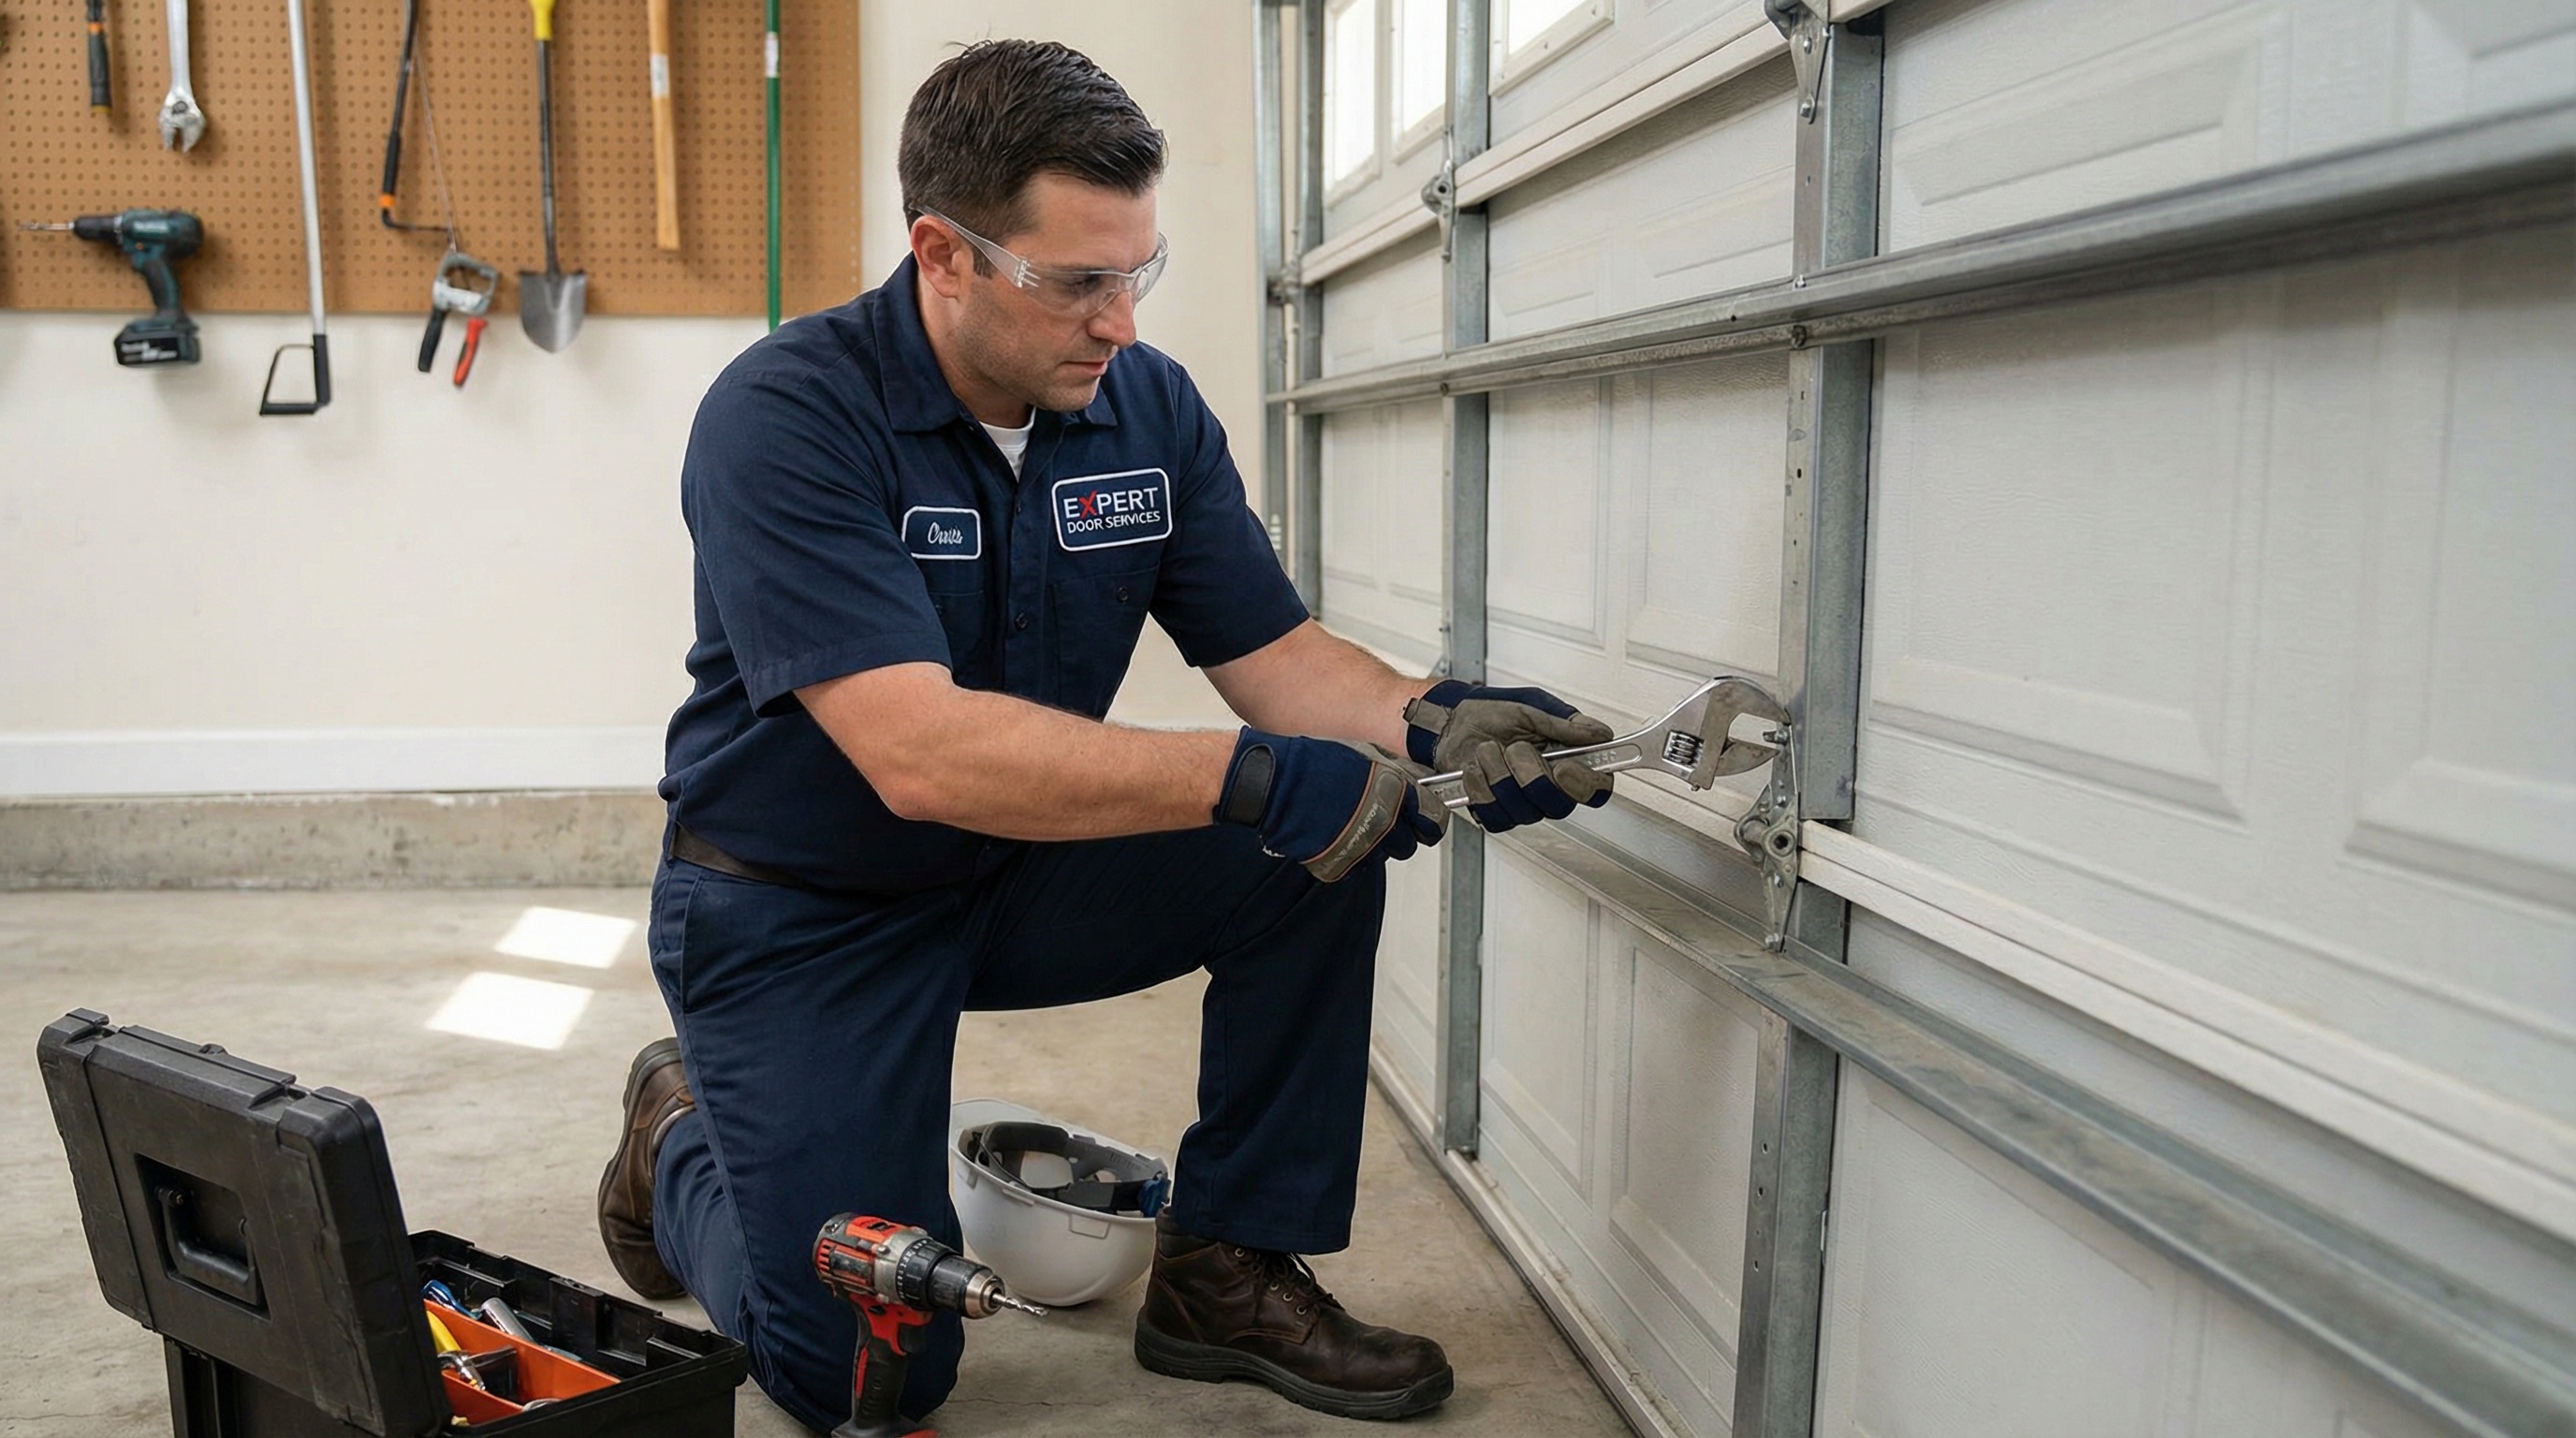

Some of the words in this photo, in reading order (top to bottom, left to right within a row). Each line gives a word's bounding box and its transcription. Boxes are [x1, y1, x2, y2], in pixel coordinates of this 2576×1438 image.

[1063, 488, 1158, 519] EXPERT
[1067, 518, 1104, 534] DOOR
[1105, 510, 1161, 529] SERVICES
